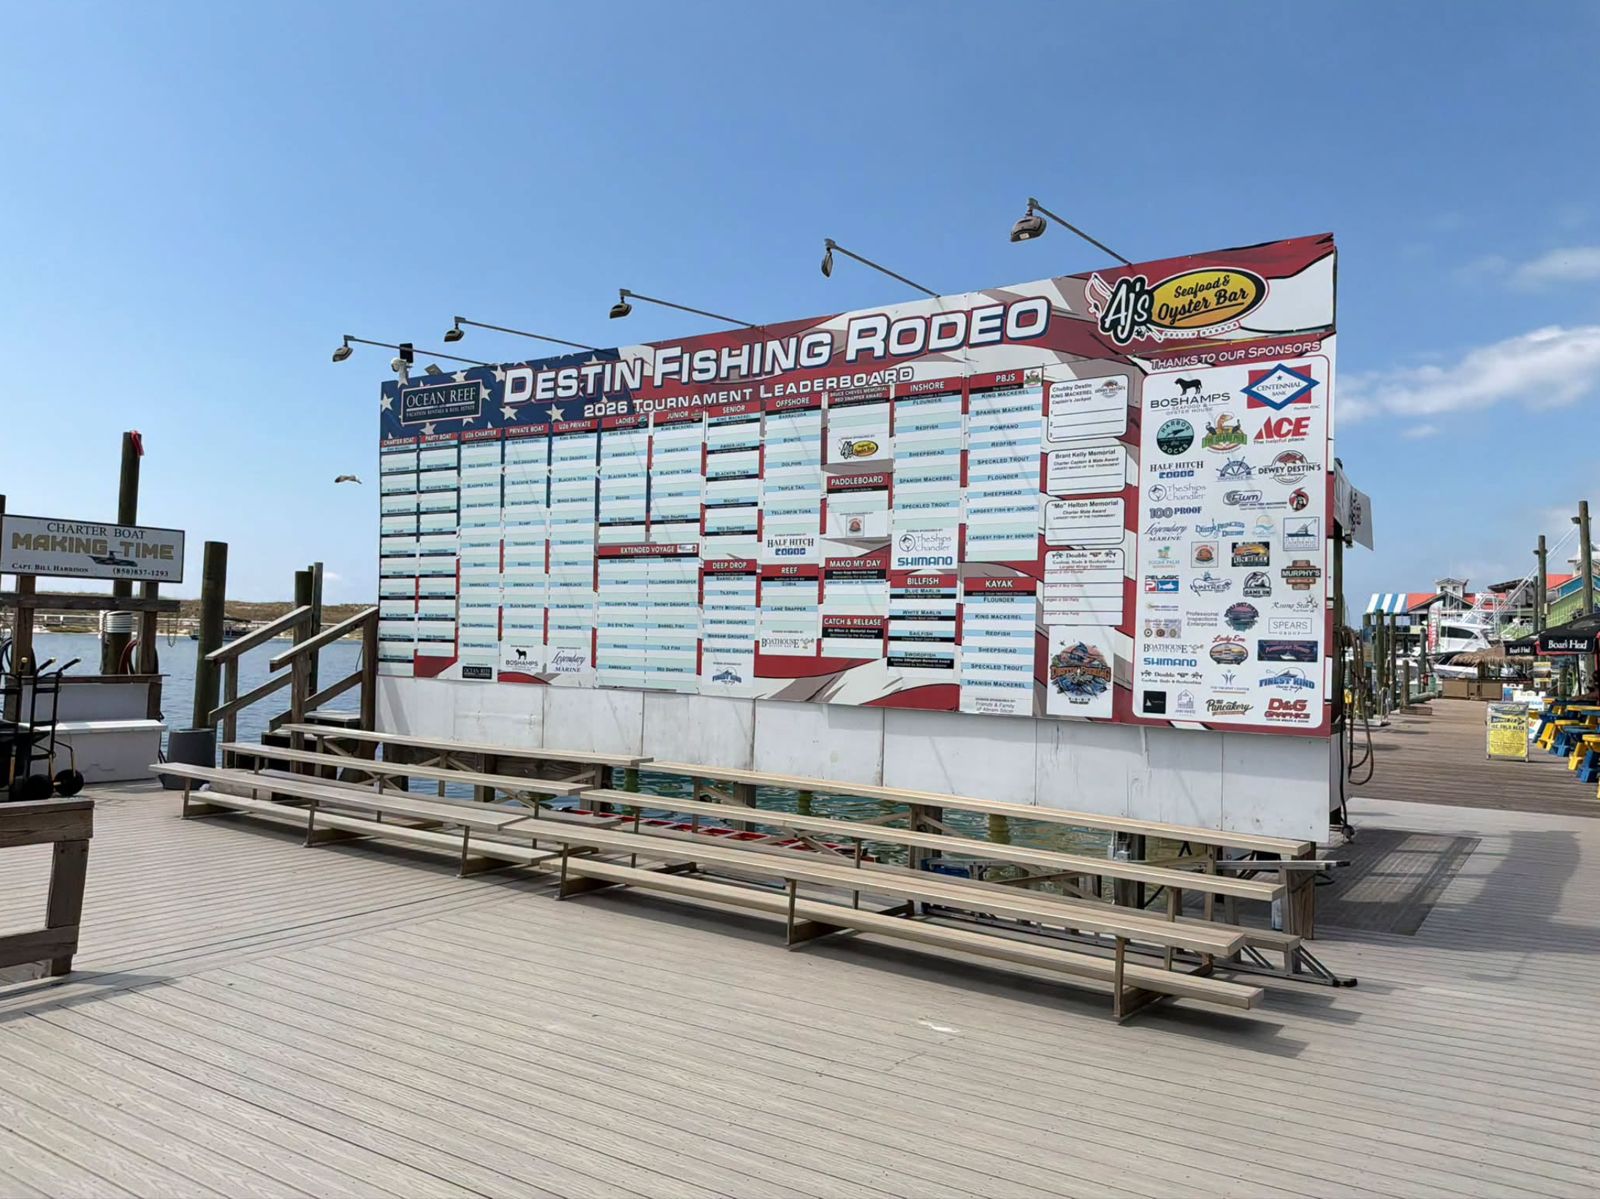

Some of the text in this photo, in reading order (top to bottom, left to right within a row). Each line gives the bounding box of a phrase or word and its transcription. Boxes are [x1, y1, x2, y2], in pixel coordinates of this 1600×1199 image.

[1174, 275, 1231, 299] Seafood &
[1157, 287, 1249, 325] Oyster Bar
[503, 297, 1050, 404] DESTIN FISHING RODEO
[1151, 341, 1322, 370] THANKS TO OUR SPONSORS
[995, 373, 1016, 382] PBJS
[910, 381, 945, 392] INSHORE
[1052, 385, 1073, 393] Chubby
[1256, 381, 1301, 392] CENTENNIAL
[584, 366, 914, 418] 2026 TOURNAMENT LEADERBOARD
[997, 389, 1029, 397] MACKEREL
[1065, 390, 1092, 398] MACKEREL
[406, 387, 476, 408] OCEAN REEF
[775, 397, 810, 408] OFFSHORE
[1150, 392, 1231, 409] BOSHAMPS
[722, 405, 746, 414] SENIOR
[1002, 406, 1034, 414] MACKEREL
[666, 411, 689, 419] JUNIOR
[615, 417, 635, 425] LADIES
[509, 426, 529, 434] PRIVATE
[989, 423, 1019, 431] POMPANO
[1253, 416, 1311, 440] ACE
[1072, 451, 1087, 459] Kelly
[1150, 460, 1204, 472] HALF HITCH
[1258, 466, 1285, 475] DEWEY
[1287, 463, 1321, 473] DESTIN'S
[831, 475, 883, 486] PADDLEBOARD
[1174, 506, 1202, 515] PROOF
[47, 522, 146, 540] CHARTER BOAT
[12, 532, 175, 560] MAKING TIME
[767, 538, 814, 548] HALF HITCH
[829, 559, 851, 568] MAKO
[866, 559, 881, 567] DAY
[897, 556, 953, 566] SHIMANO
[53, 565, 89, 573] HARRISON
[1281, 569, 1321, 577] MURPHY'S
[907, 577, 939, 585] BILLFISH
[985, 580, 1014, 588] KAYAK
[853, 618, 881, 626] RELEASE
[1272, 621, 1308, 630] SPEARS
[761, 639, 800, 649] BOATHOUSE
[1143, 643, 1188, 654] BOATHOUSE
[1143, 657, 1198, 667] SHIMANO
[993, 681, 1026, 689] MACKEREL
[1205, 699, 1251, 712] Pancakery
[1267, 698, 1309, 712] D&G
